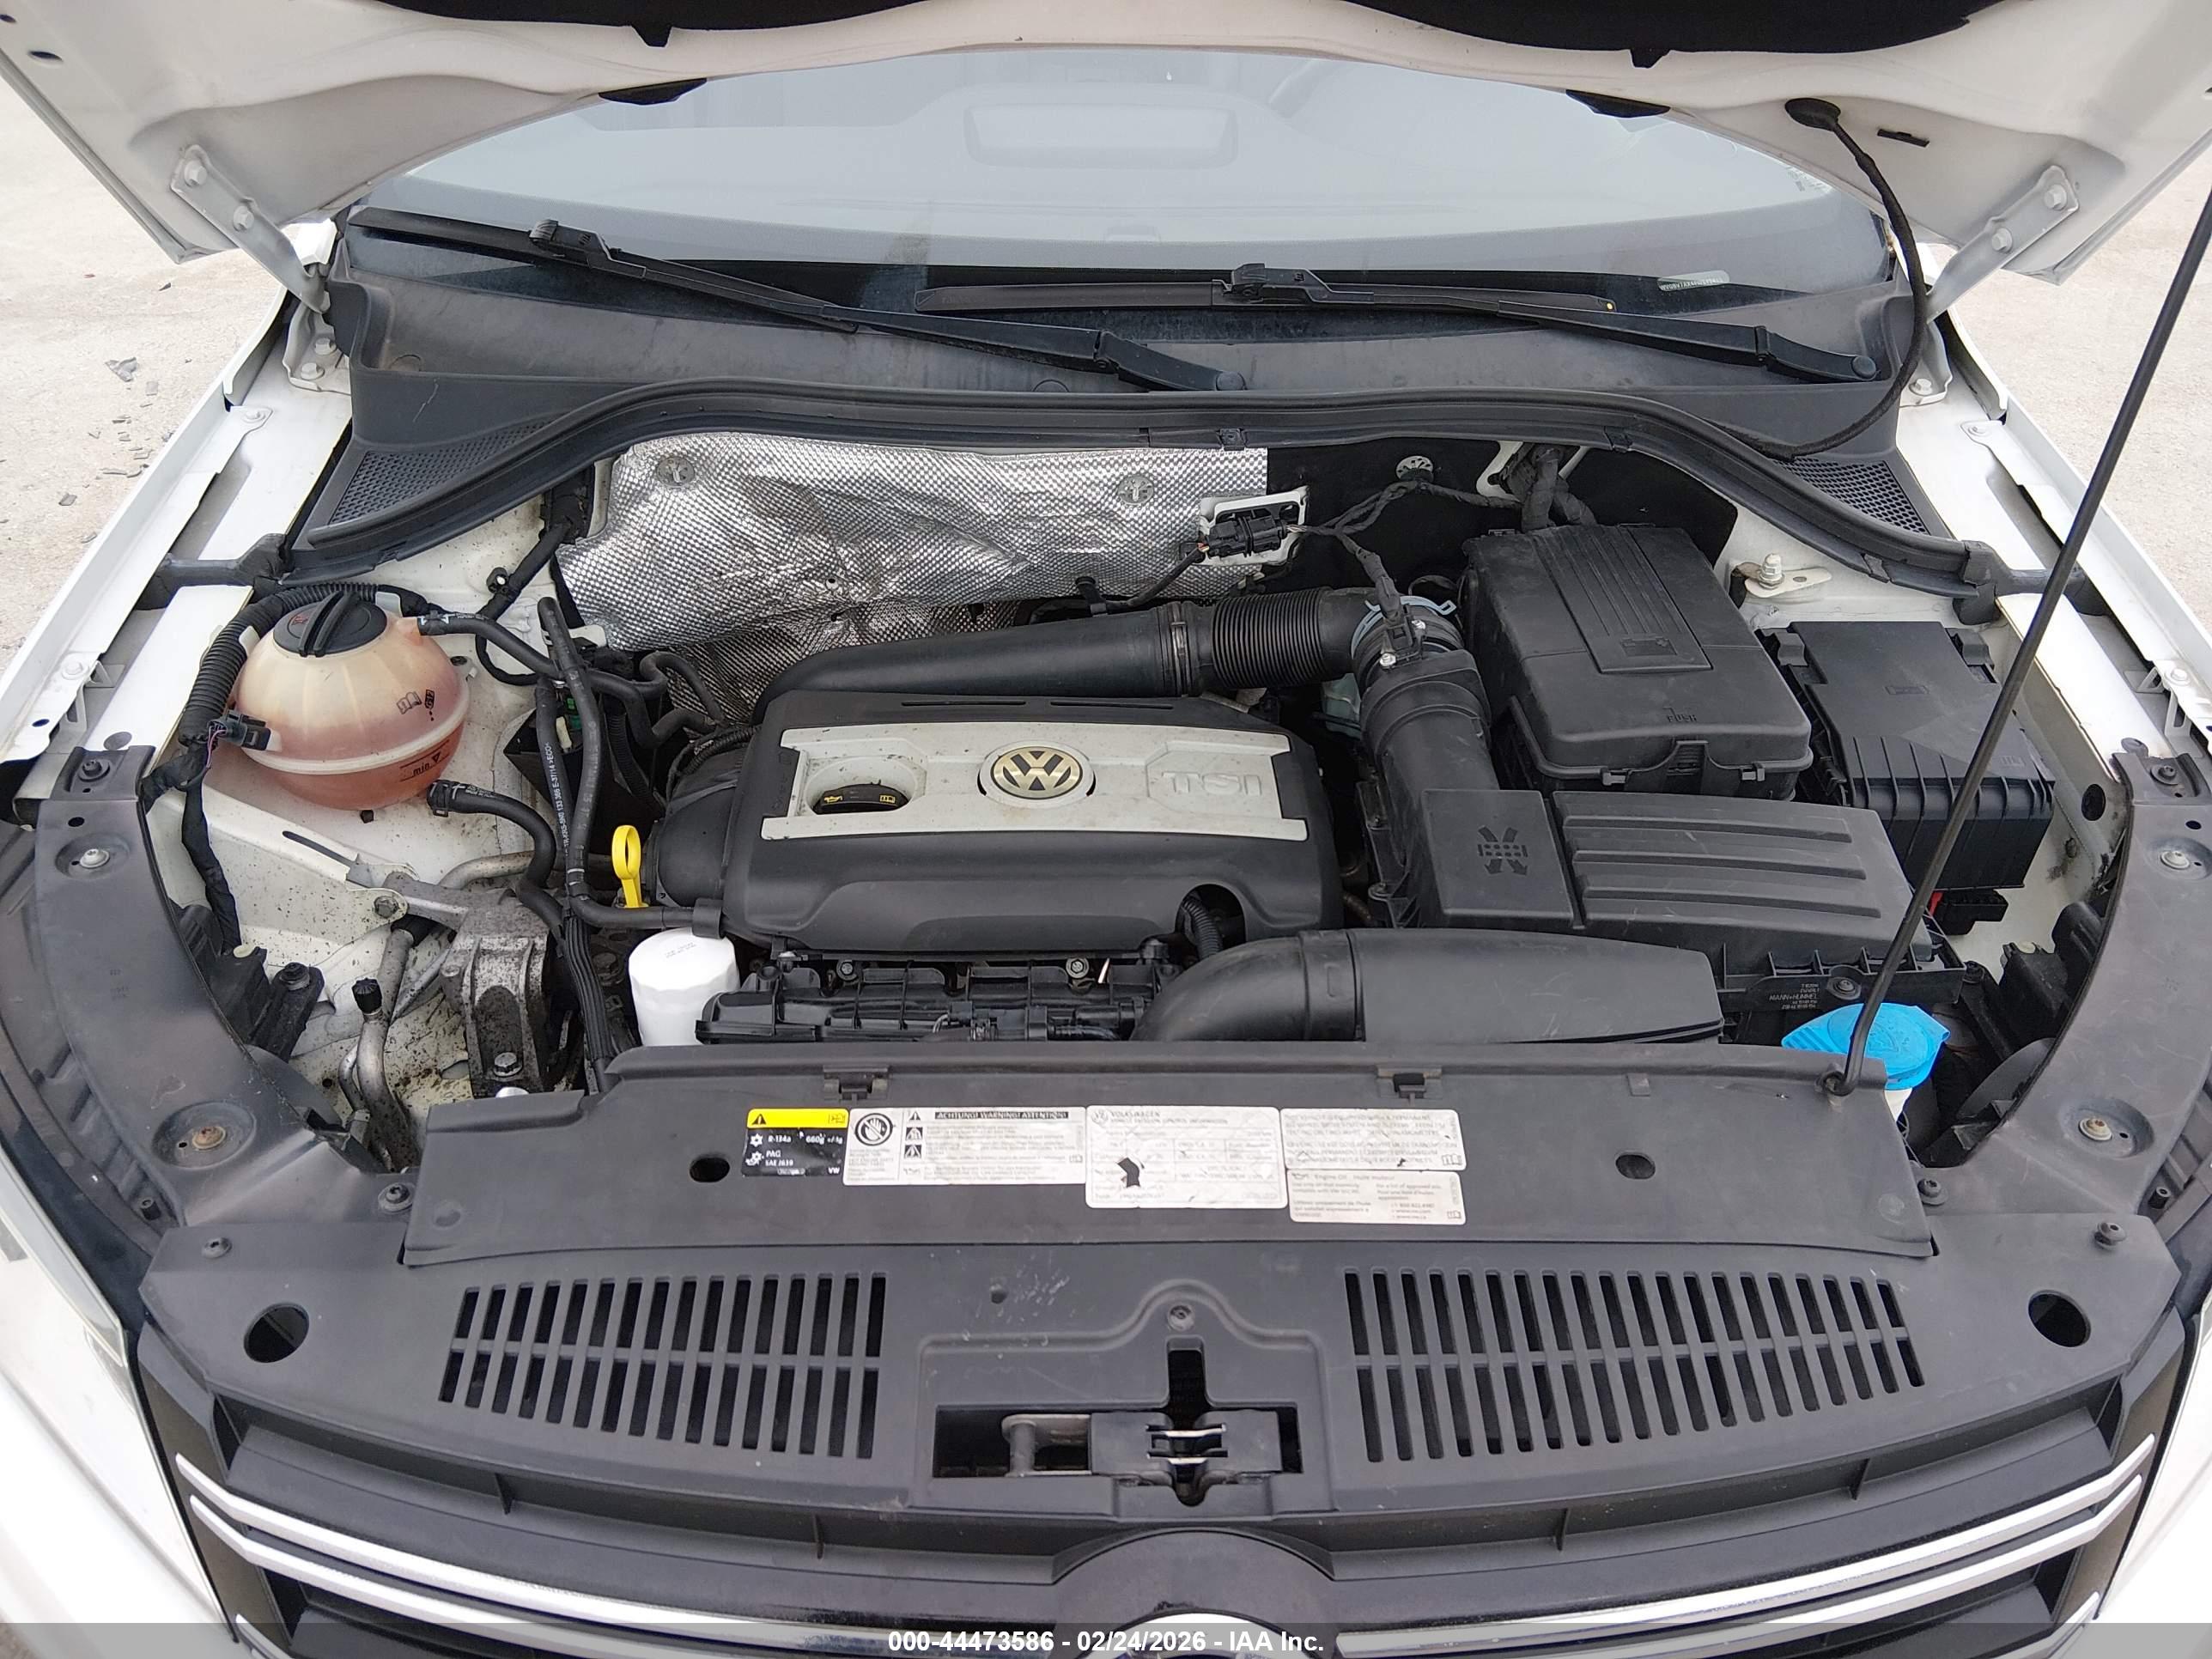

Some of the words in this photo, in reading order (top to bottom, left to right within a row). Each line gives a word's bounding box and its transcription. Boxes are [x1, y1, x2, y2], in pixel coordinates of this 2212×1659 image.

[1667, 714, 1698, 722] PUSH
[413, 763, 430, 776] min
[1161, 770, 1262, 796] TSI
[555, 800, 564, 811] 133
